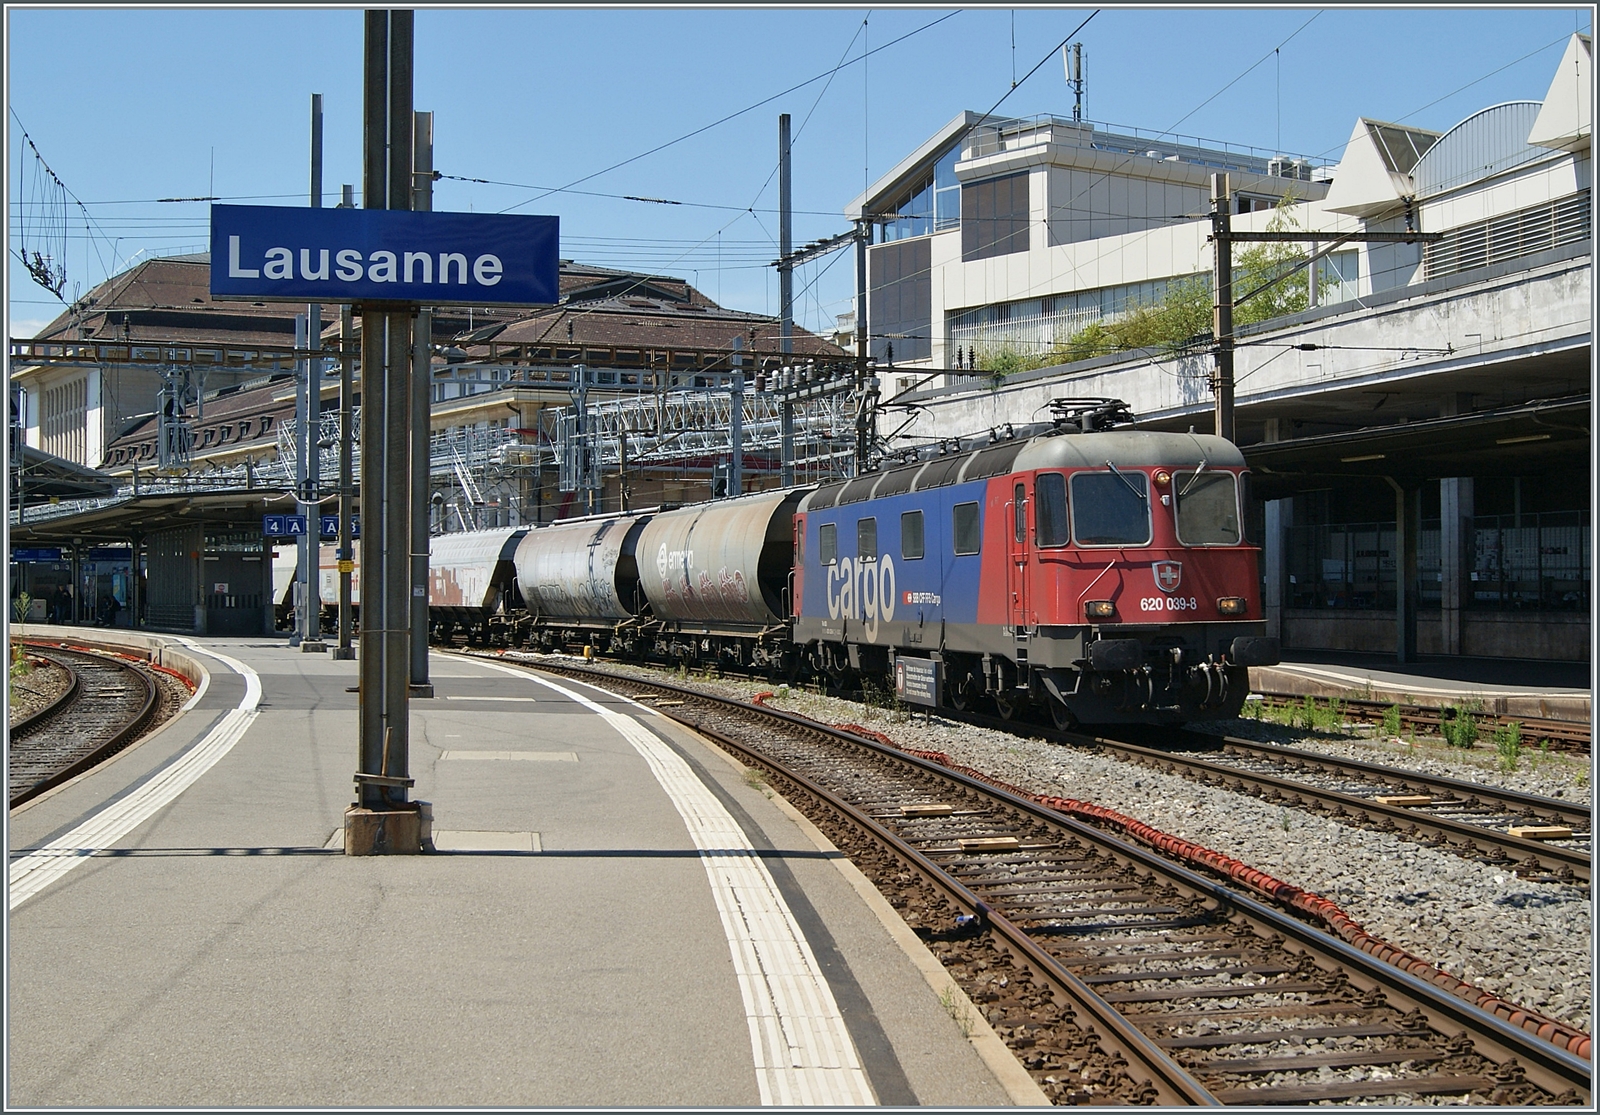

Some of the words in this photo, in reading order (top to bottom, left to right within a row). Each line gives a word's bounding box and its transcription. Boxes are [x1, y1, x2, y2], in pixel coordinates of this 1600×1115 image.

[229, 235, 503, 287] Lausanne
[270, 522, 279, 532] 4
[290, 522, 300, 532] A
[327, 522, 337, 532] A
[827, 553, 896, 644] cargo
[1140, 598, 1164, 611] 620
[1166, 597, 1197, 611] 039-8
